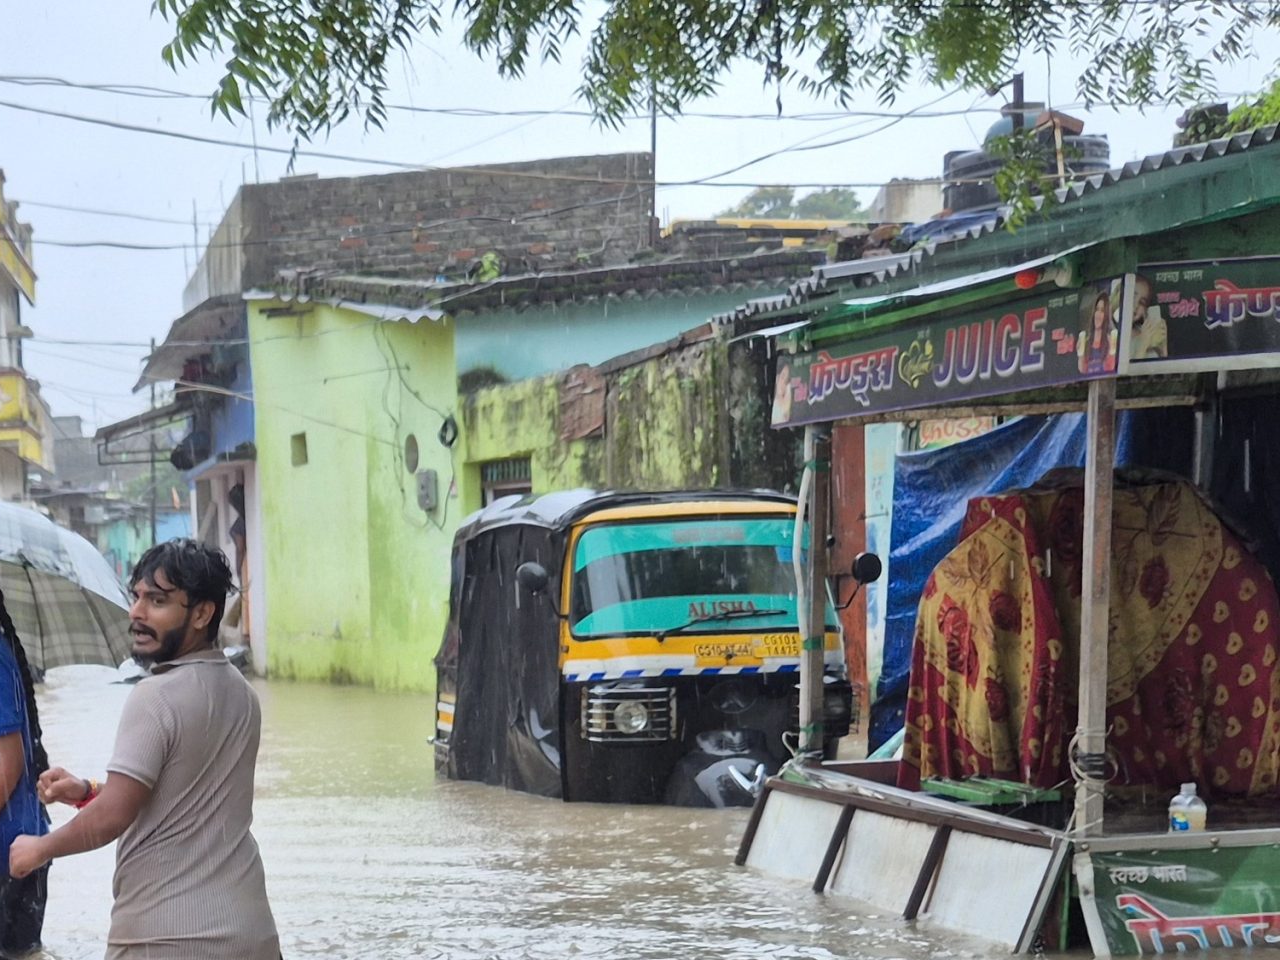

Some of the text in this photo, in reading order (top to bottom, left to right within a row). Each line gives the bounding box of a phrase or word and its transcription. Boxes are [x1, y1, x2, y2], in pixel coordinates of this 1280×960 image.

[933, 307, 1048, 387] JUICE
[689, 601, 756, 618] ALISHA
[1109, 864, 1188, 885] स्वच्छ भारत
